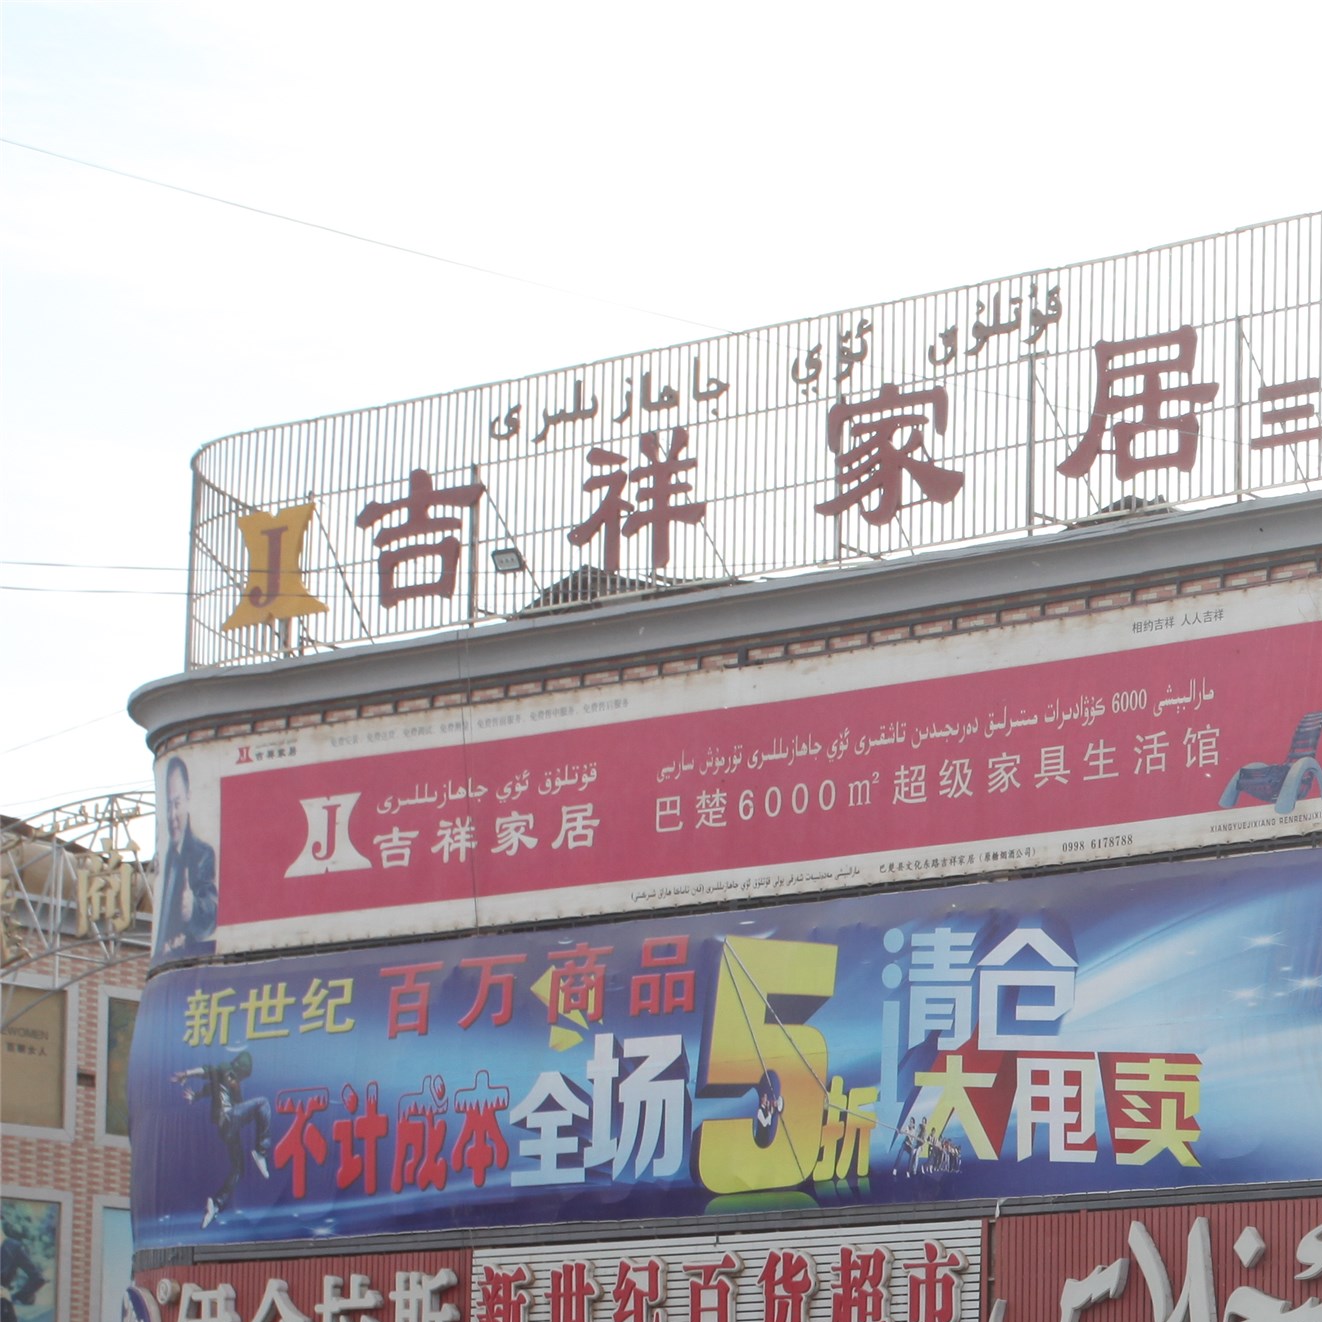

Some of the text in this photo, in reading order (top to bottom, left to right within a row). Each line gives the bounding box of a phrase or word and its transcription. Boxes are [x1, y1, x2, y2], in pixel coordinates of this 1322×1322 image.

[356, 328, 1219, 610] 吉祥家居
[248, 525, 290, 608] J
[1132, 608, 1225, 635] 相约吉祥 人人吉祥
[1111, 688, 1147, 714] 6000
[495, 769, 531, 805] ئۆي
[310, 805, 342, 862] J
[372, 802, 601, 869] 吉祥家居
[1062, 834, 1133, 852] 0998 6178788
[183, 934, 695, 1048] 新世纪 百万商品
[273, 1069, 510, 1199] 不计成本
[912, 1054, 1203, 1168] 大甩卖
